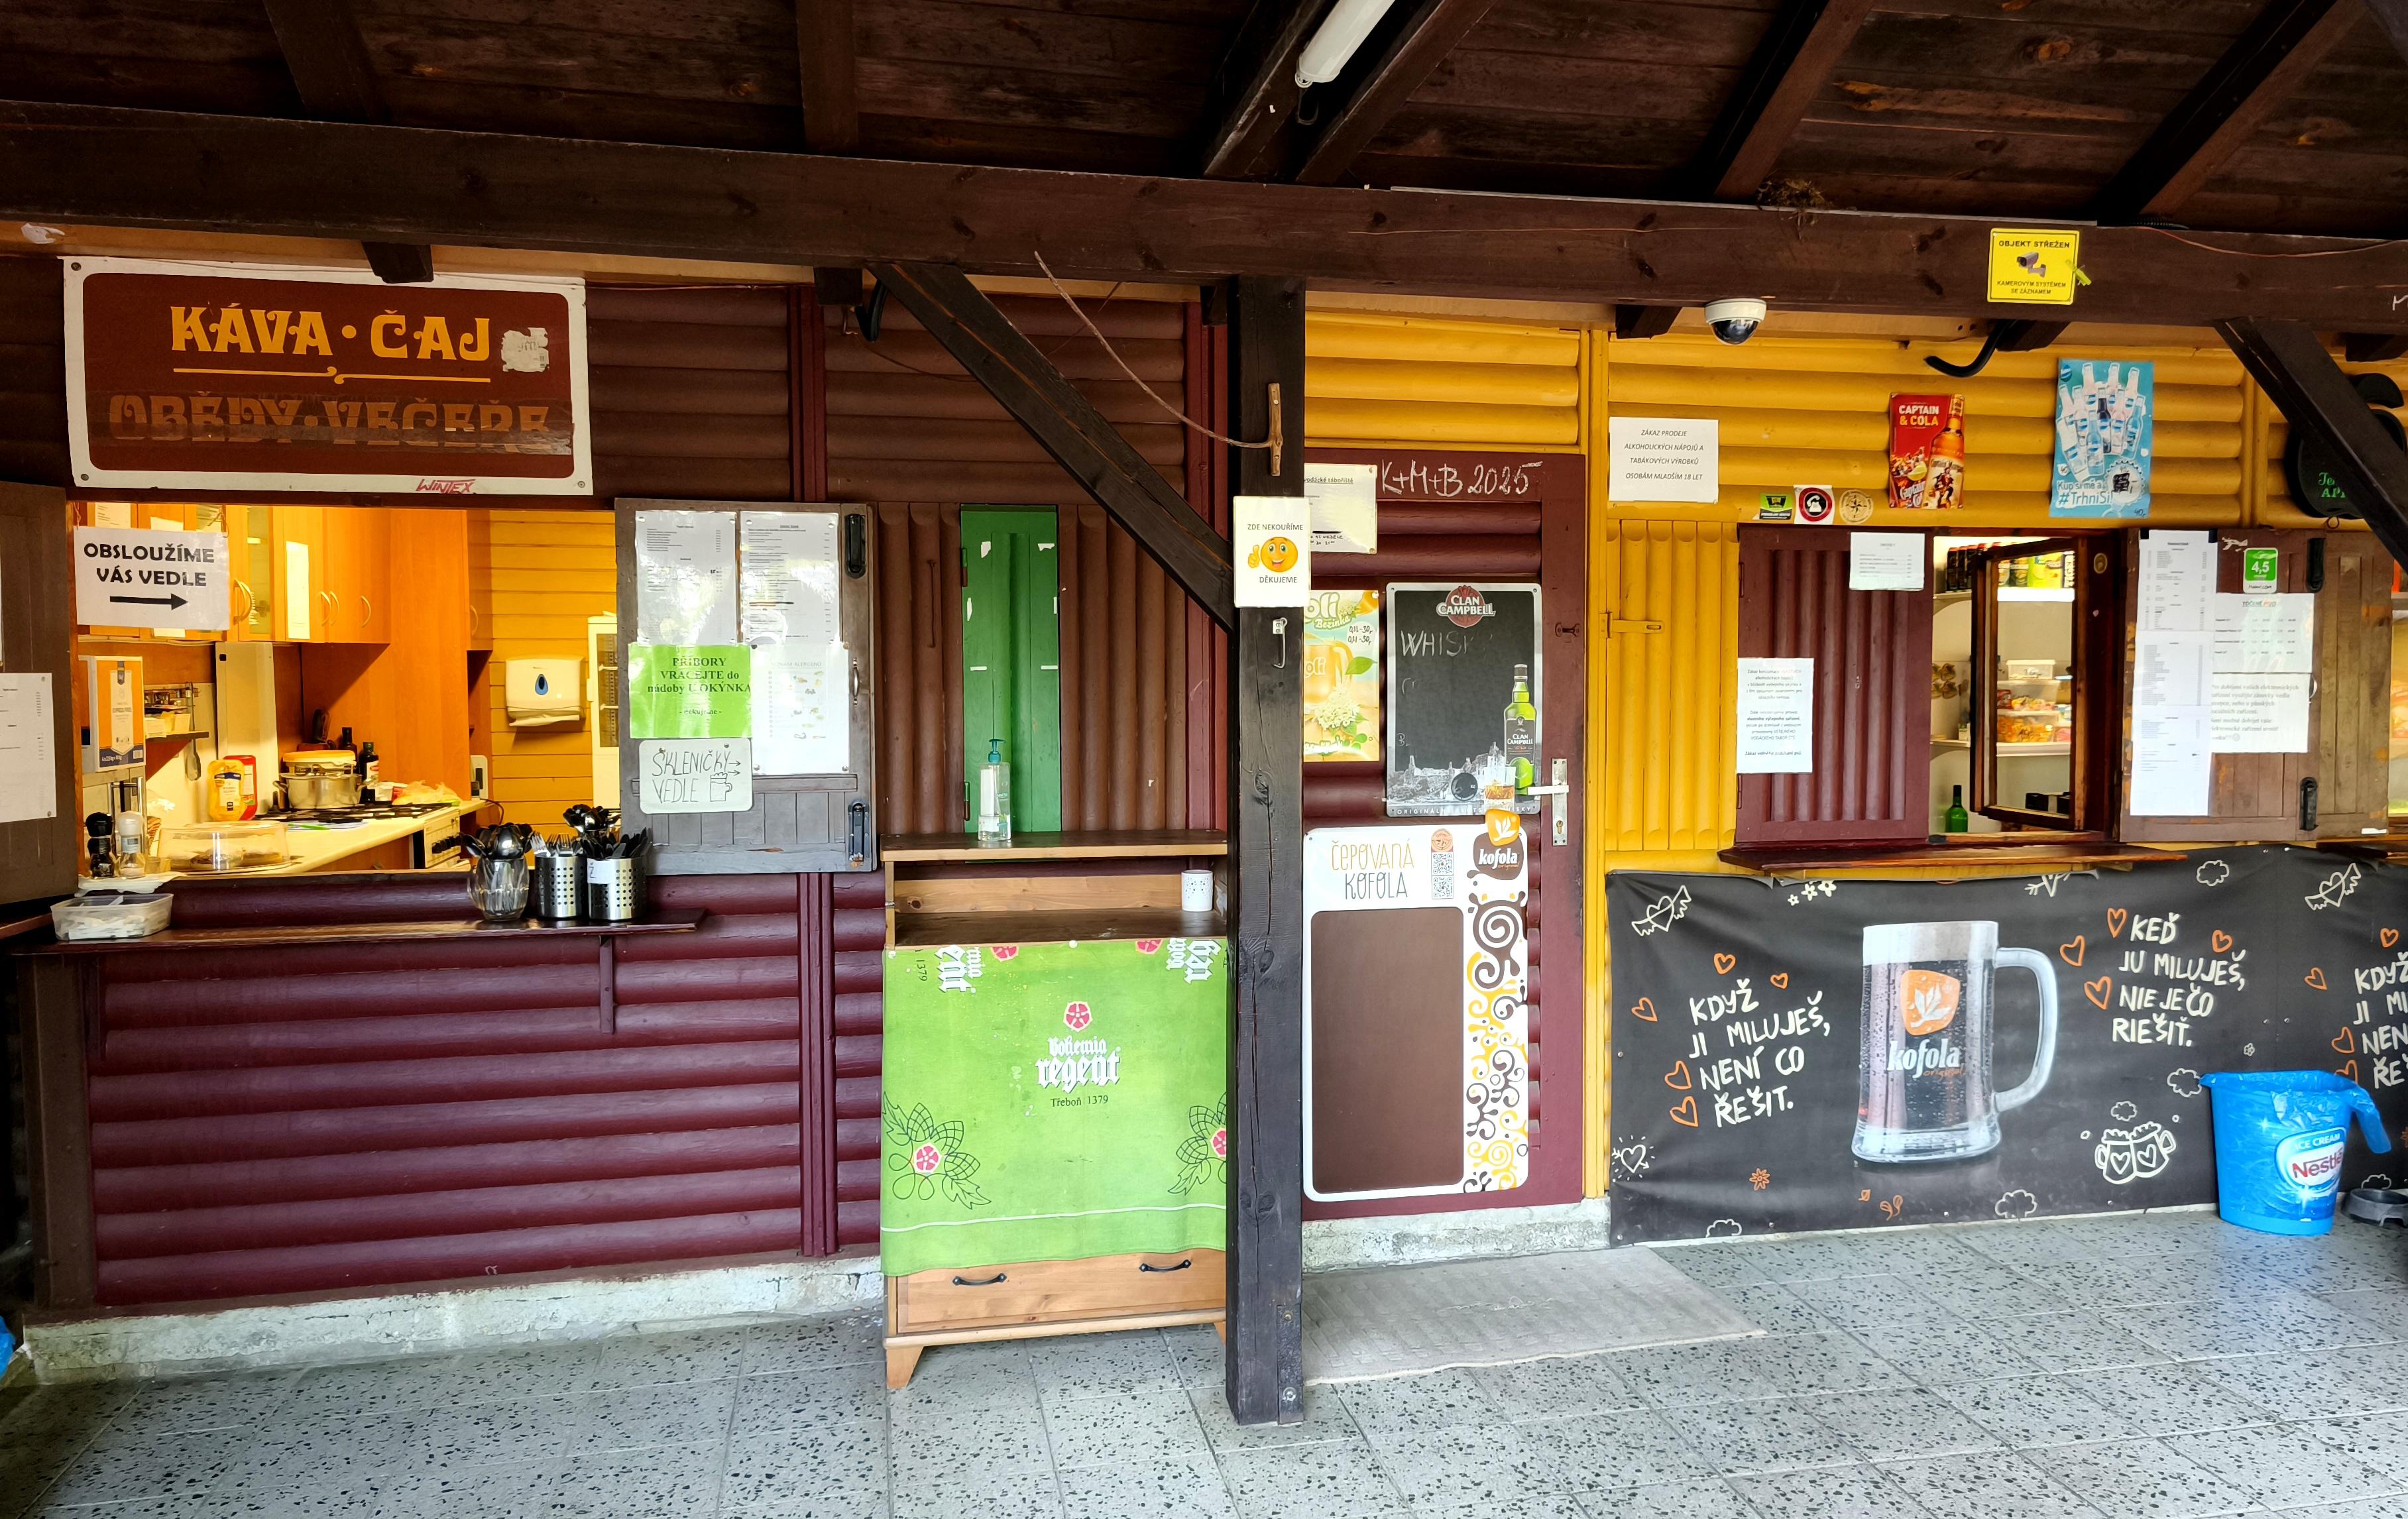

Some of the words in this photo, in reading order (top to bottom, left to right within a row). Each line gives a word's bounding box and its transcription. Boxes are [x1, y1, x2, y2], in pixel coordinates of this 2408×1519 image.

[2034, 239, 2070, 249] STŘEŽEN
[170, 302, 333, 356] KÁVA
[370, 309, 491, 363] ČAJ
[1898, 405, 1940, 415] CAPTAIN
[1899, 416, 1908, 425] &
[1910, 416, 1939, 426] COLA
[415, 478, 477, 495] WINTEX
[1467, 461, 1544, 496] 2025
[2057, 482, 2073, 492] Kup
[2084, 479, 2095, 489] mě
[1261, 522, 1304, 532] NEKOUŘÍME
[83, 543, 215, 564] OBSLOUŽÍME
[96, 566, 133, 586] VÁS
[139, 569, 207, 587] VEDLE
[2251, 561, 2270, 574] 4,5
[1259, 575, 1298, 584] DĚKUJEME
[1437, 602, 1494, 616] CAMPBELL
[1450, 594, 1480, 606] CLAN
[1314, 615, 1351, 630] Bezinka
[672, 655, 727, 667] PŘÍBORY
[659, 670, 724, 680] VRACEJTE
[727, 671, 740, 680] do
[648, 683, 685, 695] nádoby
[699, 681, 751, 693] OKÝNKA
[652, 750, 732, 777] SKLENIČKY
[652, 778, 699, 804] VEDLE
[1478, 848, 1519, 870] kofola
[1345, 872, 1408, 901] KOFOLA
[2130, 913, 2180, 944] KEĎ
[2119, 950, 2145, 974] JU
[2153, 949, 2249, 991] MILUJEŠ,
[1689, 979, 1760, 1026] KDYŽ
[2119, 985, 2156, 1011] NIE
[2159, 988, 2183, 1012] JE
[2186, 982, 2215, 1018] ČO
[2353, 1000, 2370, 1025] JI
[2386, 991, 2408, 1015] MI
[1689, 1032, 1707, 1059] JI
[1727, 990, 1831, 1049] MILUJEŠ,
[1047, 1035, 1108, 1058] Bohemia
[2362, 1023, 2408, 1056] NEN
[1699, 1045, 1764, 1092] NENÍ
[1775, 1045, 1806, 1076] CO
[1886, 1039, 1961, 1080] kofola
[1034, 1050, 1121, 1094] regent
[2373, 1053, 2408, 1090] ŘE
[1049, 1095, 1082, 1108] Třeboň
[1086, 1094, 1110, 1105] 1379
[1714, 1085, 1794, 1128] ŘEŠIT.
[2312, 1133, 2340, 1147] CREAM
[2291, 1147, 2344, 1178] Nestlé
